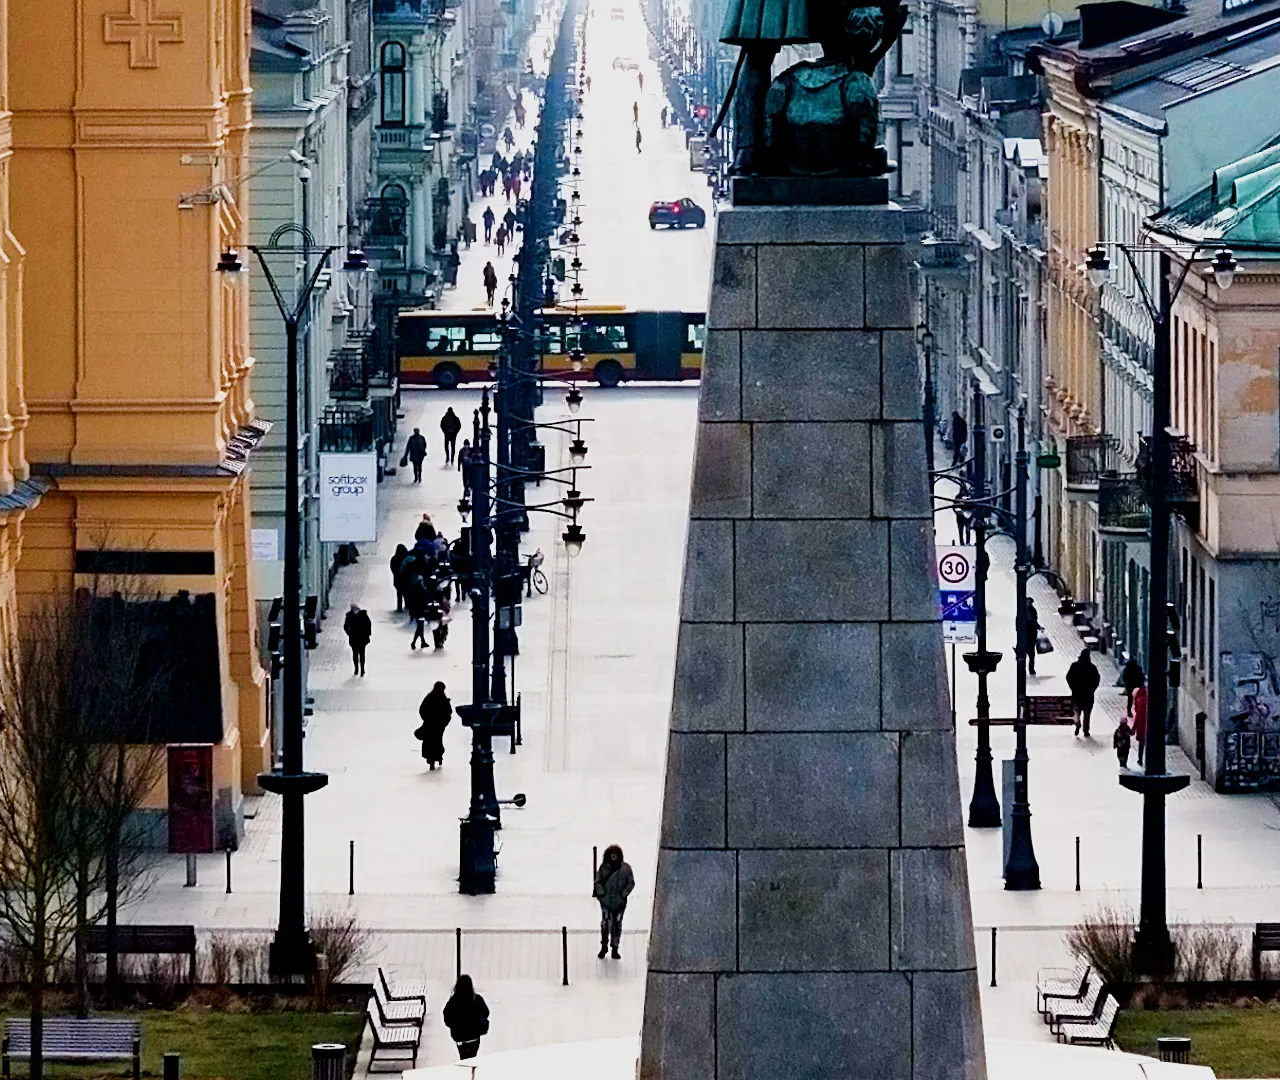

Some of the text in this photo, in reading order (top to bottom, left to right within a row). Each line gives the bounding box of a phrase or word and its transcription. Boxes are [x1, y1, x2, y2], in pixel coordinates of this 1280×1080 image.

[328, 474, 368, 485] softbox
[331, 485, 364, 497] group
[944, 561, 965, 575] 30
